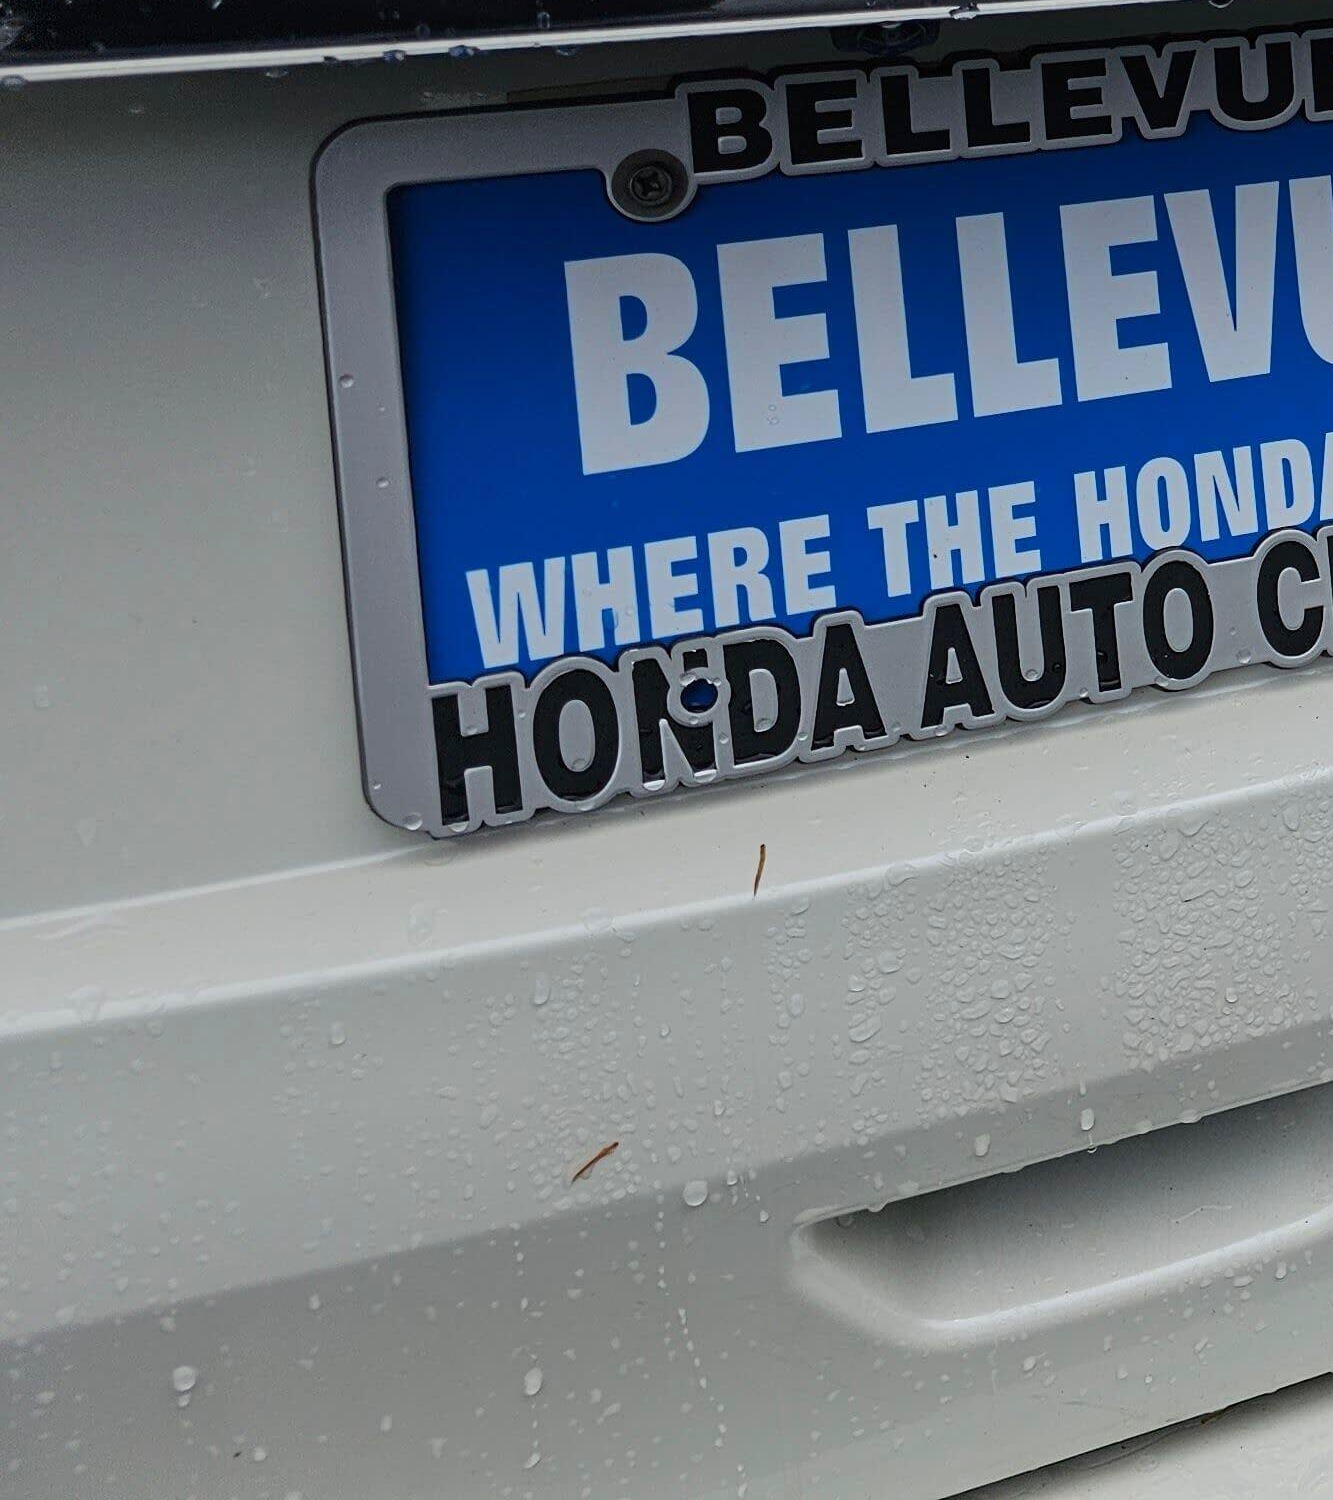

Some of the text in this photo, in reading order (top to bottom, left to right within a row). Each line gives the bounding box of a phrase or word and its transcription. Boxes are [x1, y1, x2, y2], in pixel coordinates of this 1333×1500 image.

[430, 622, 889, 827] HONDA
[920, 549, 1215, 729] AUTO
[466, 514, 837, 669] WHERE
[867, 483, 1047, 599] THE
